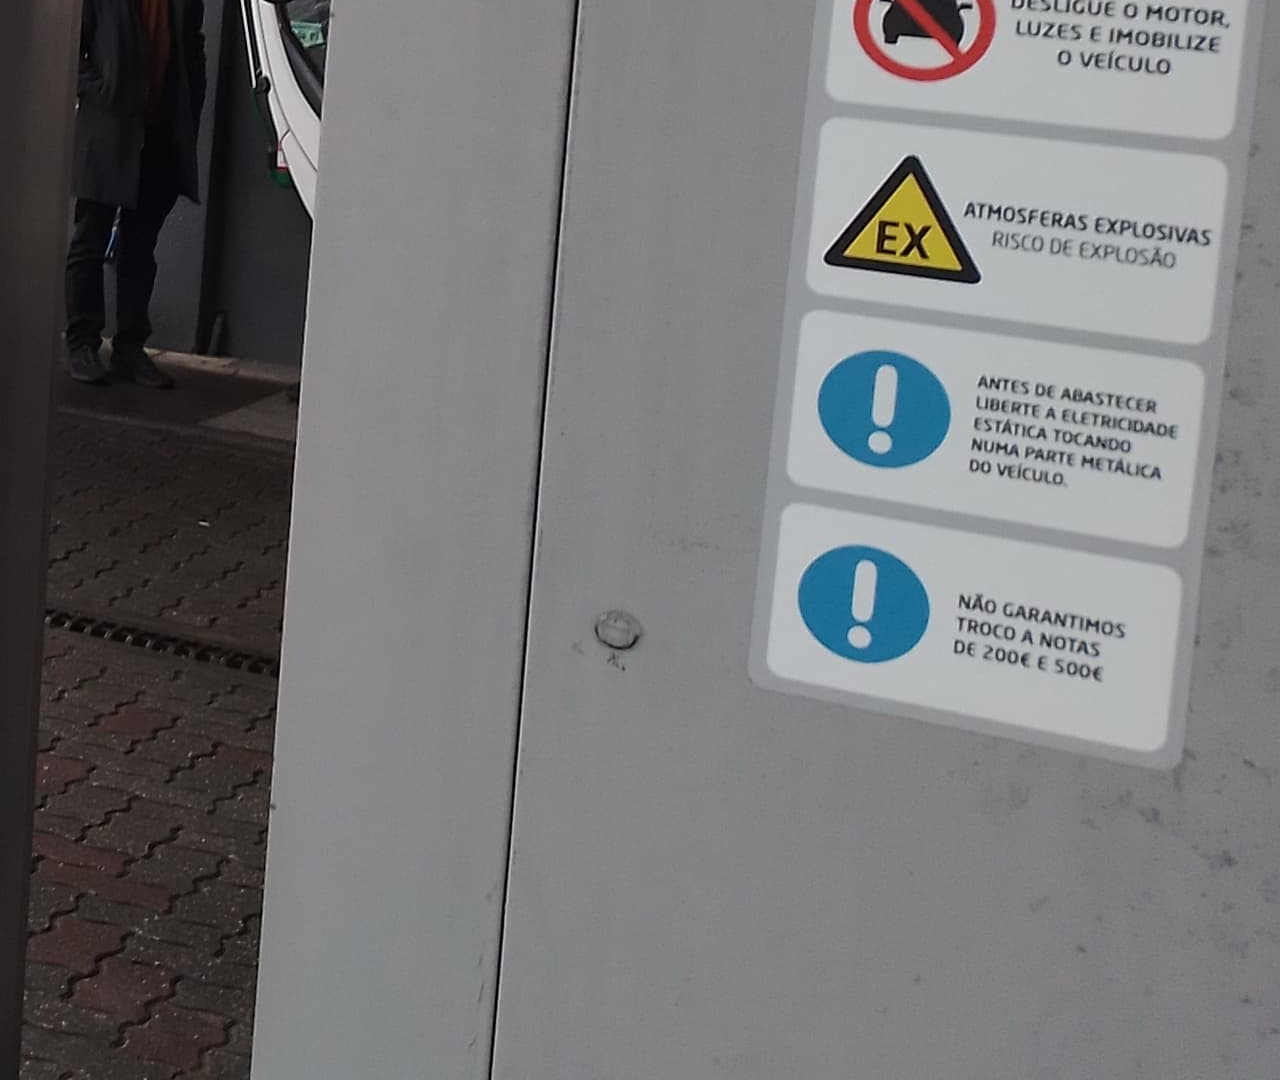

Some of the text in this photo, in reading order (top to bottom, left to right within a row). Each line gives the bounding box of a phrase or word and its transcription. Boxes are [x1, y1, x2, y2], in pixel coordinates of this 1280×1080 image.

[1122, 2, 1139, 20] O
[1015, 19, 1220, 53] LUZES E IMOBILIZE
[1057, 49, 1172, 76] O VEÍCULO
[876, 219, 931, 260] EX
[963, 201, 1211, 247] ATMOSFERAS EXPLOSIVAS
[991, 230, 1177, 270] RISCO DE EXPLOSÃO
[977, 375, 1157, 414] ANTES DE ABASTECER
[973, 417, 1132, 454] ESTÁTICA TOCANDO
[975, 395, 1177, 440] LIBERTE A ELETRICIDADE
[968, 458, 992, 475] DO
[970, 437, 1162, 481] NUMA PARTE METÁLICA
[958, 593, 1126, 639] NÃO GARANTIMOS
[957, 616, 1101, 658] TROCO A NOTAS
[953, 639, 1103, 682] DE 200€ E 500€
